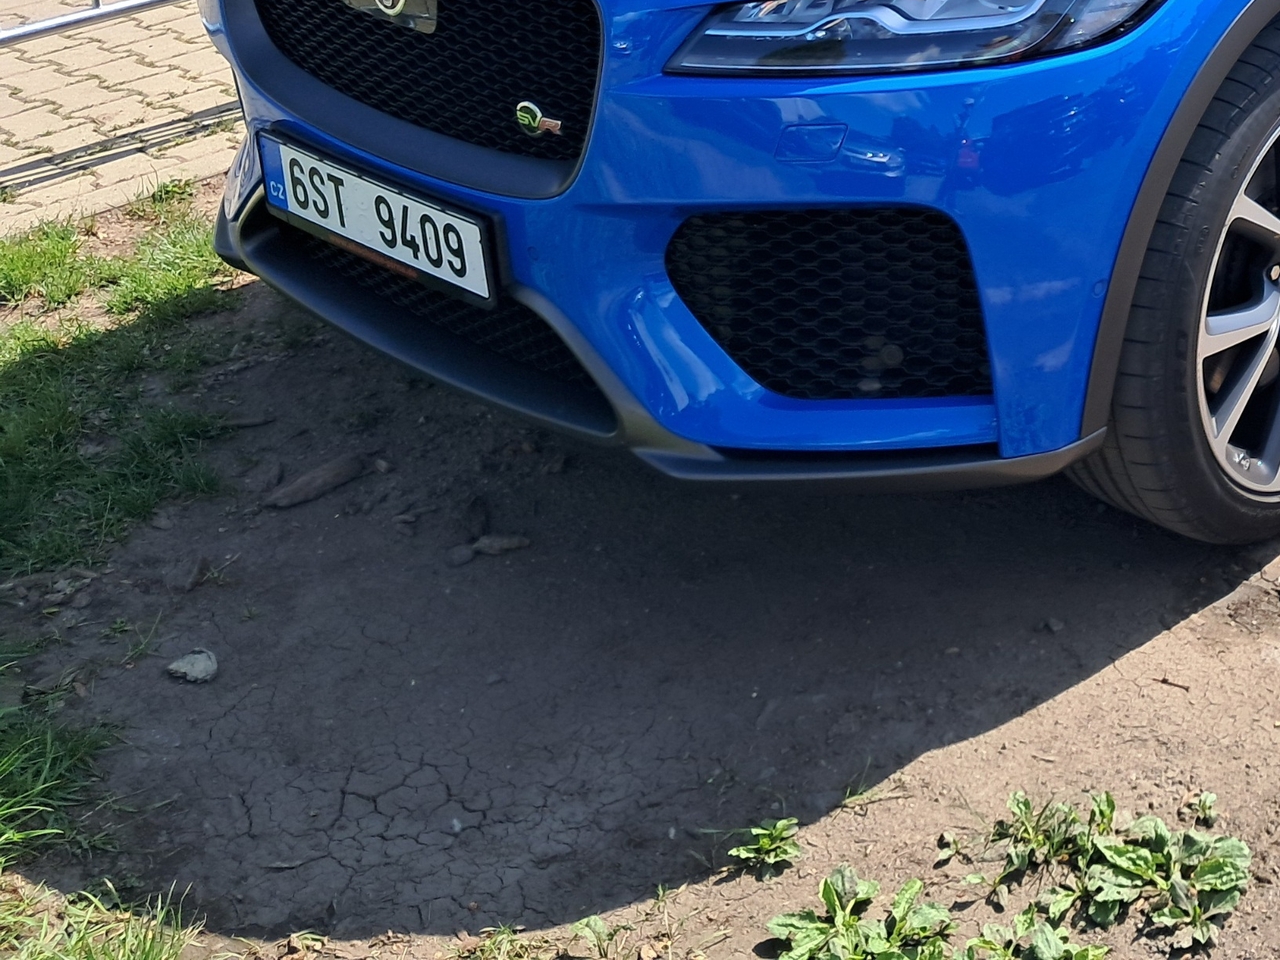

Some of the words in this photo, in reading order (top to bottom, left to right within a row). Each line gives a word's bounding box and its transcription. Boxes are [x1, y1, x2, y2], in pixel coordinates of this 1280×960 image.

[269, 180, 286, 200] CZ
[288, 157, 346, 229] 6ST
[374, 194, 467, 279] 9409
